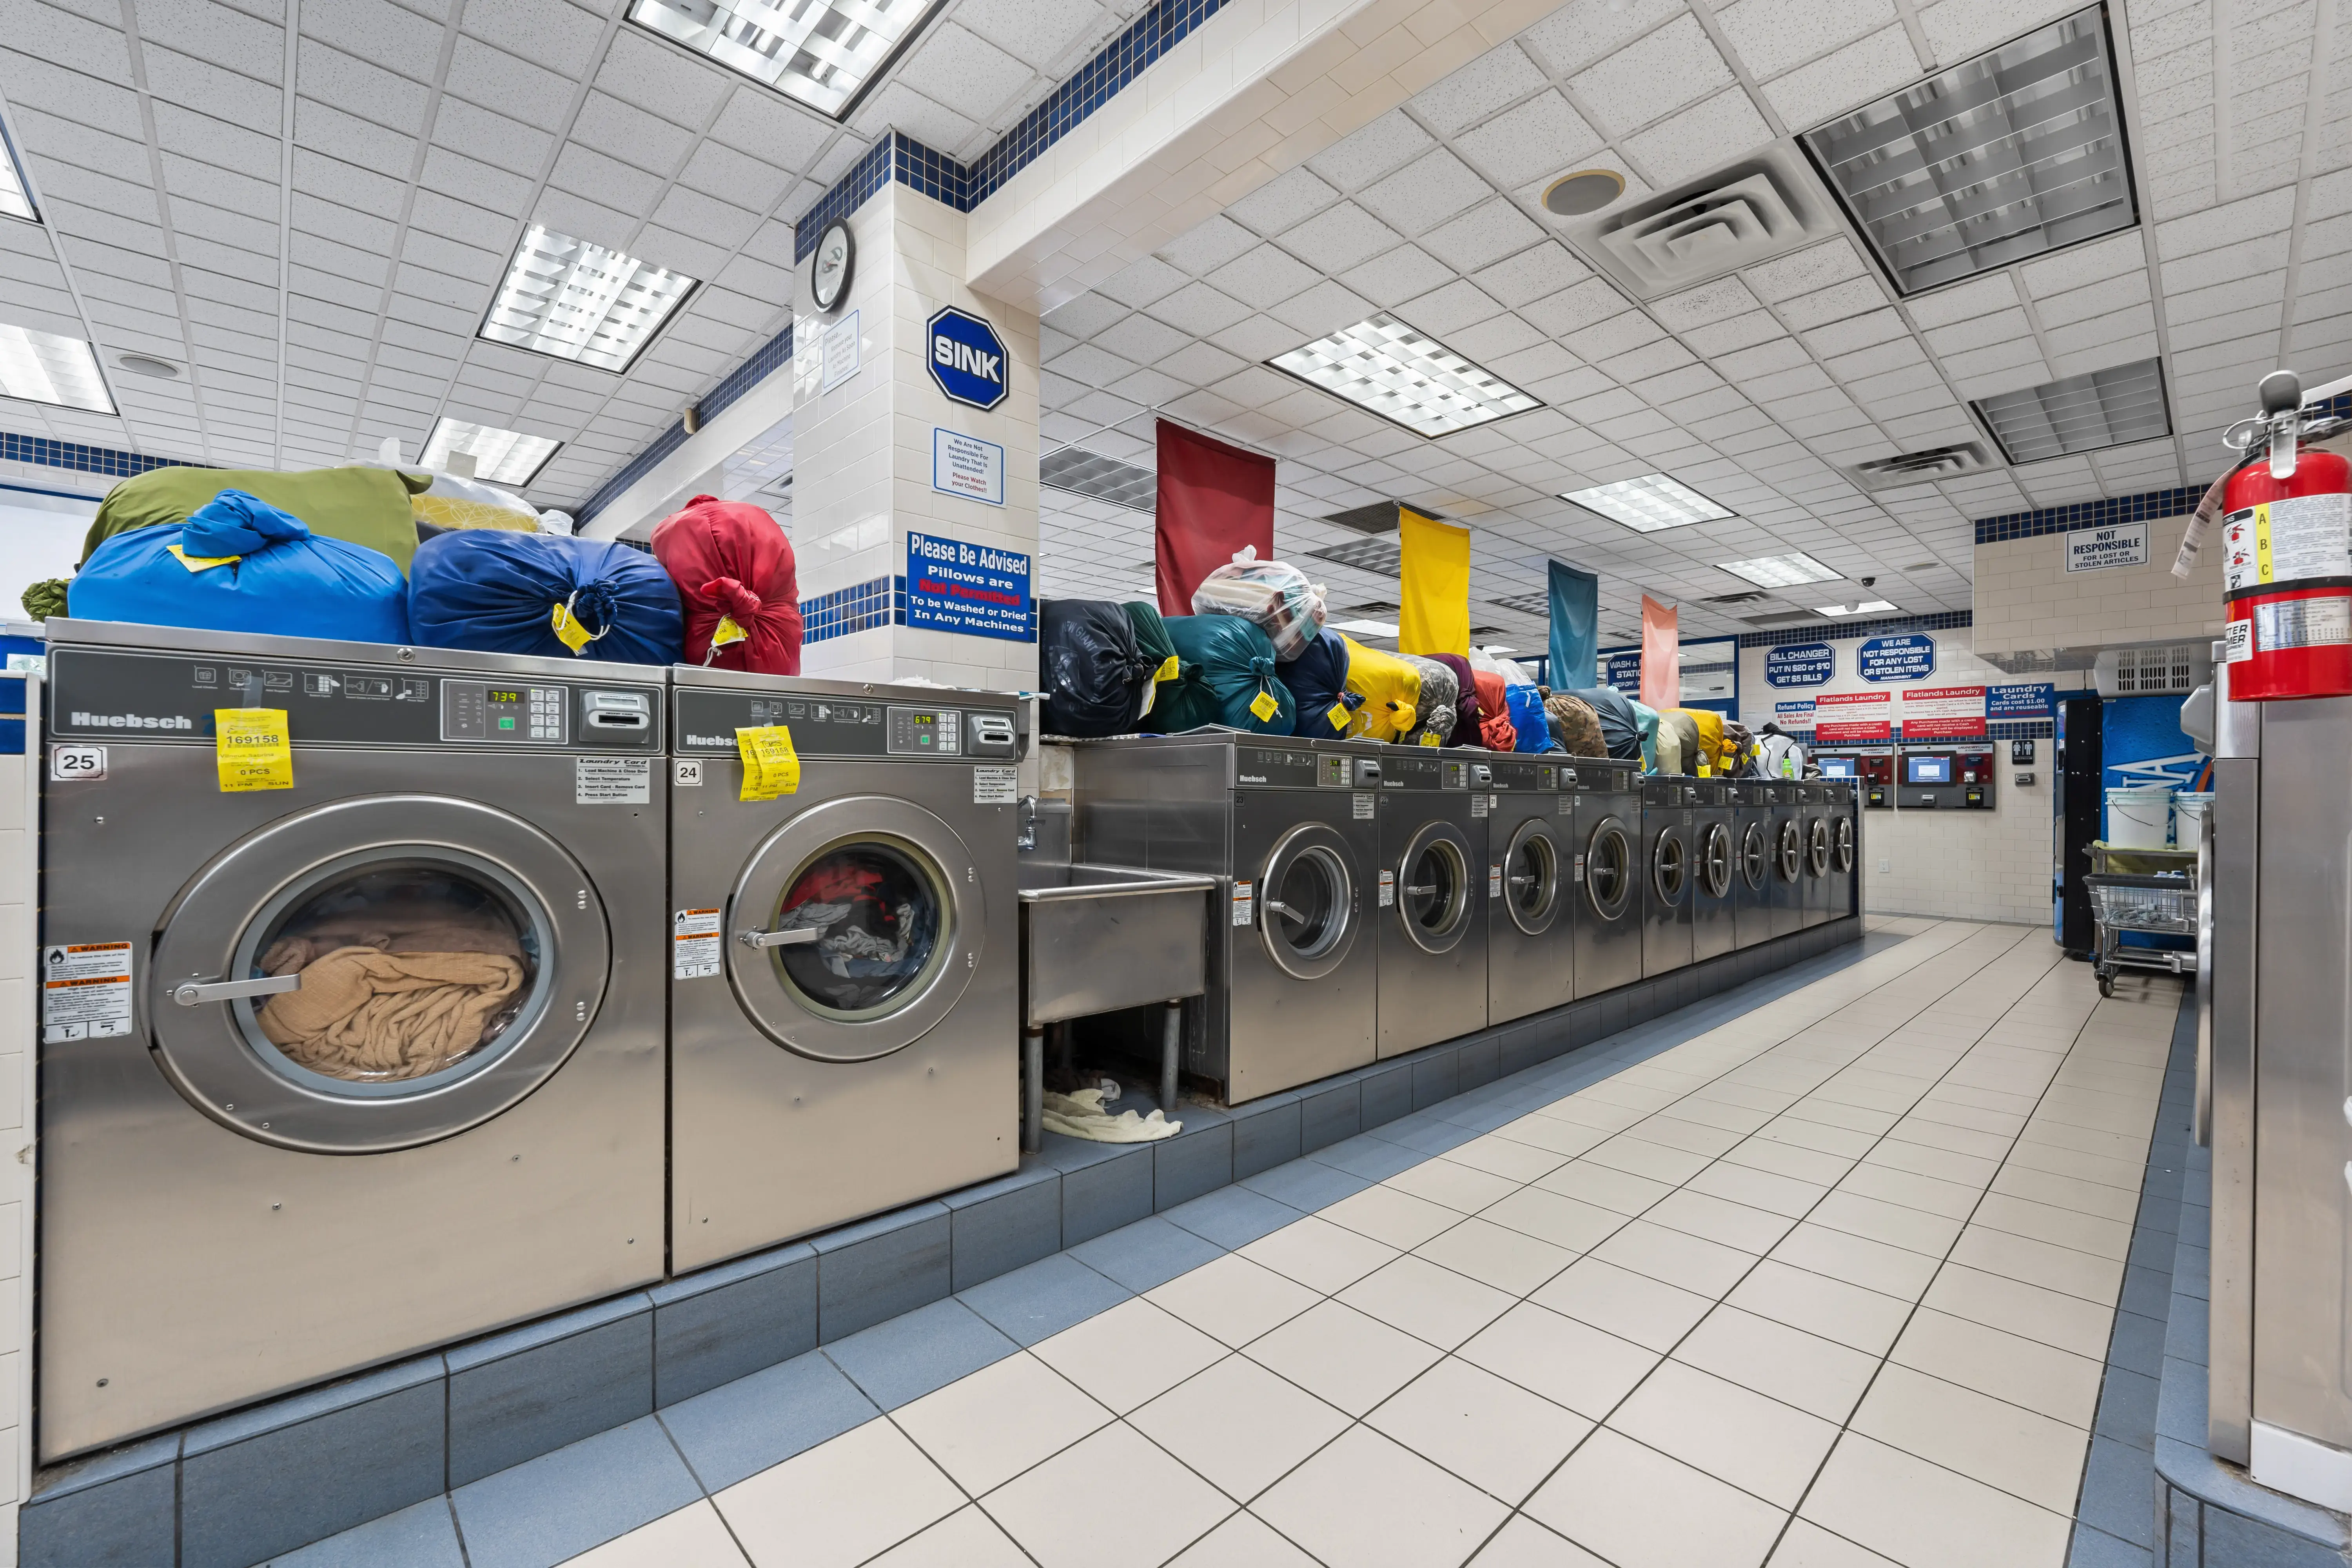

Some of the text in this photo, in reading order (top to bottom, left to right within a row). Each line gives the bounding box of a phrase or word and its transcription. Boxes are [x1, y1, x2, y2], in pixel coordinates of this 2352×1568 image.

[828, 351, 841, 363] Laundry
[847, 341, 855, 351] Soon
[831, 340, 844, 352] Remove
[837, 354, 851, 366] Machine
[935, 335, 1000, 383] SINK
[948, 445, 979, 457] Responsible
[949, 453, 969, 463] Laundry
[953, 462, 984, 474] Unattended!
[953, 472, 986, 485] Please Watch
[965, 483, 987, 493] Clothes!!
[2259, 514, 2266, 524] A
[2097, 530, 2116, 541] NOT
[2074, 538, 2140, 555] RESPONSIBLE
[2260, 539, 2267, 550] B
[912, 534, 1027, 575] Please Be Advised
[2104, 556, 2139, 565] ARTICLES
[2262, 564, 2269, 575] C
[928, 565, 1013, 589] Pillows are
[919, 579, 1020, 606] Not Permitted
[910, 595, 924, 605] To
[927, 596, 940, 608] be
[944, 601, 984, 615] Washed
[1001, 610, 1026, 621] Dried
[914, 610, 1024, 632] In Any Machines
[1075, 626, 1098, 652] GIANT
[1770, 649, 1829, 661] BILL CHANGER
[1880, 646, 1930, 656] RESPONSIBLE
[1610, 660, 1631, 669] WASH
[1876, 666, 1904, 675] STOLEN
[1992, 685, 2047, 694] Laundry
[492, 691, 517, 702] 739
[1260, 698, 1274, 709] 168880
[71, 712, 192, 730] Huebsch
[226, 735, 278, 744] 169158
[686, 734, 739, 746] Huebsc
[64, 755, 94, 770] 25
[680, 768, 697, 778] 24
[70, 977, 118, 986] WARNING
